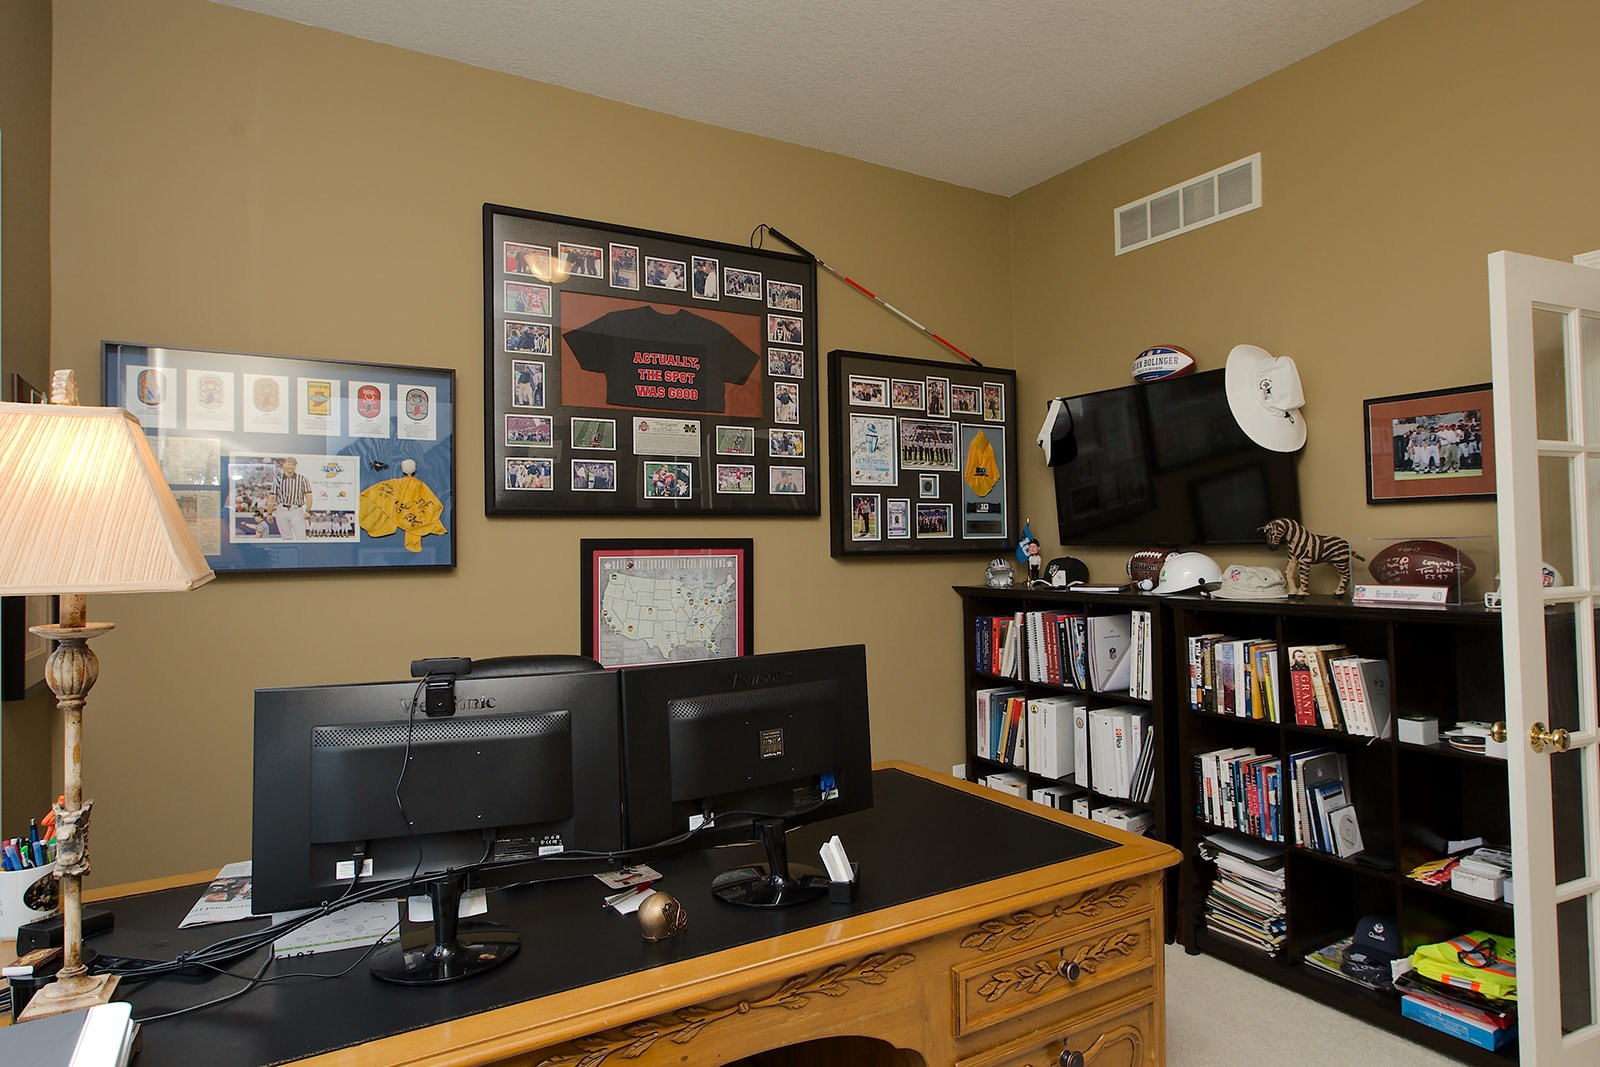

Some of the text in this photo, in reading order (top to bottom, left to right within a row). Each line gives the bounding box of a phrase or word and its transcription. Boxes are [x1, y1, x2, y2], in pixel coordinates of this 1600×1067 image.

[633, 352, 700, 370] ACTUALLY,
[1143, 356, 1179, 368] BOLINGER
[638, 369, 695, 384] THE SPOT
[635, 385, 699, 401] WAS GOOD
[1134, 561, 1158, 570] Wilson
[1375, 589, 1392, 598] Brian
[1393, 590, 1420, 600] Bolinger
[1300, 674, 1313, 717] GRANT
[399, 693, 496, 714] Vieonic
